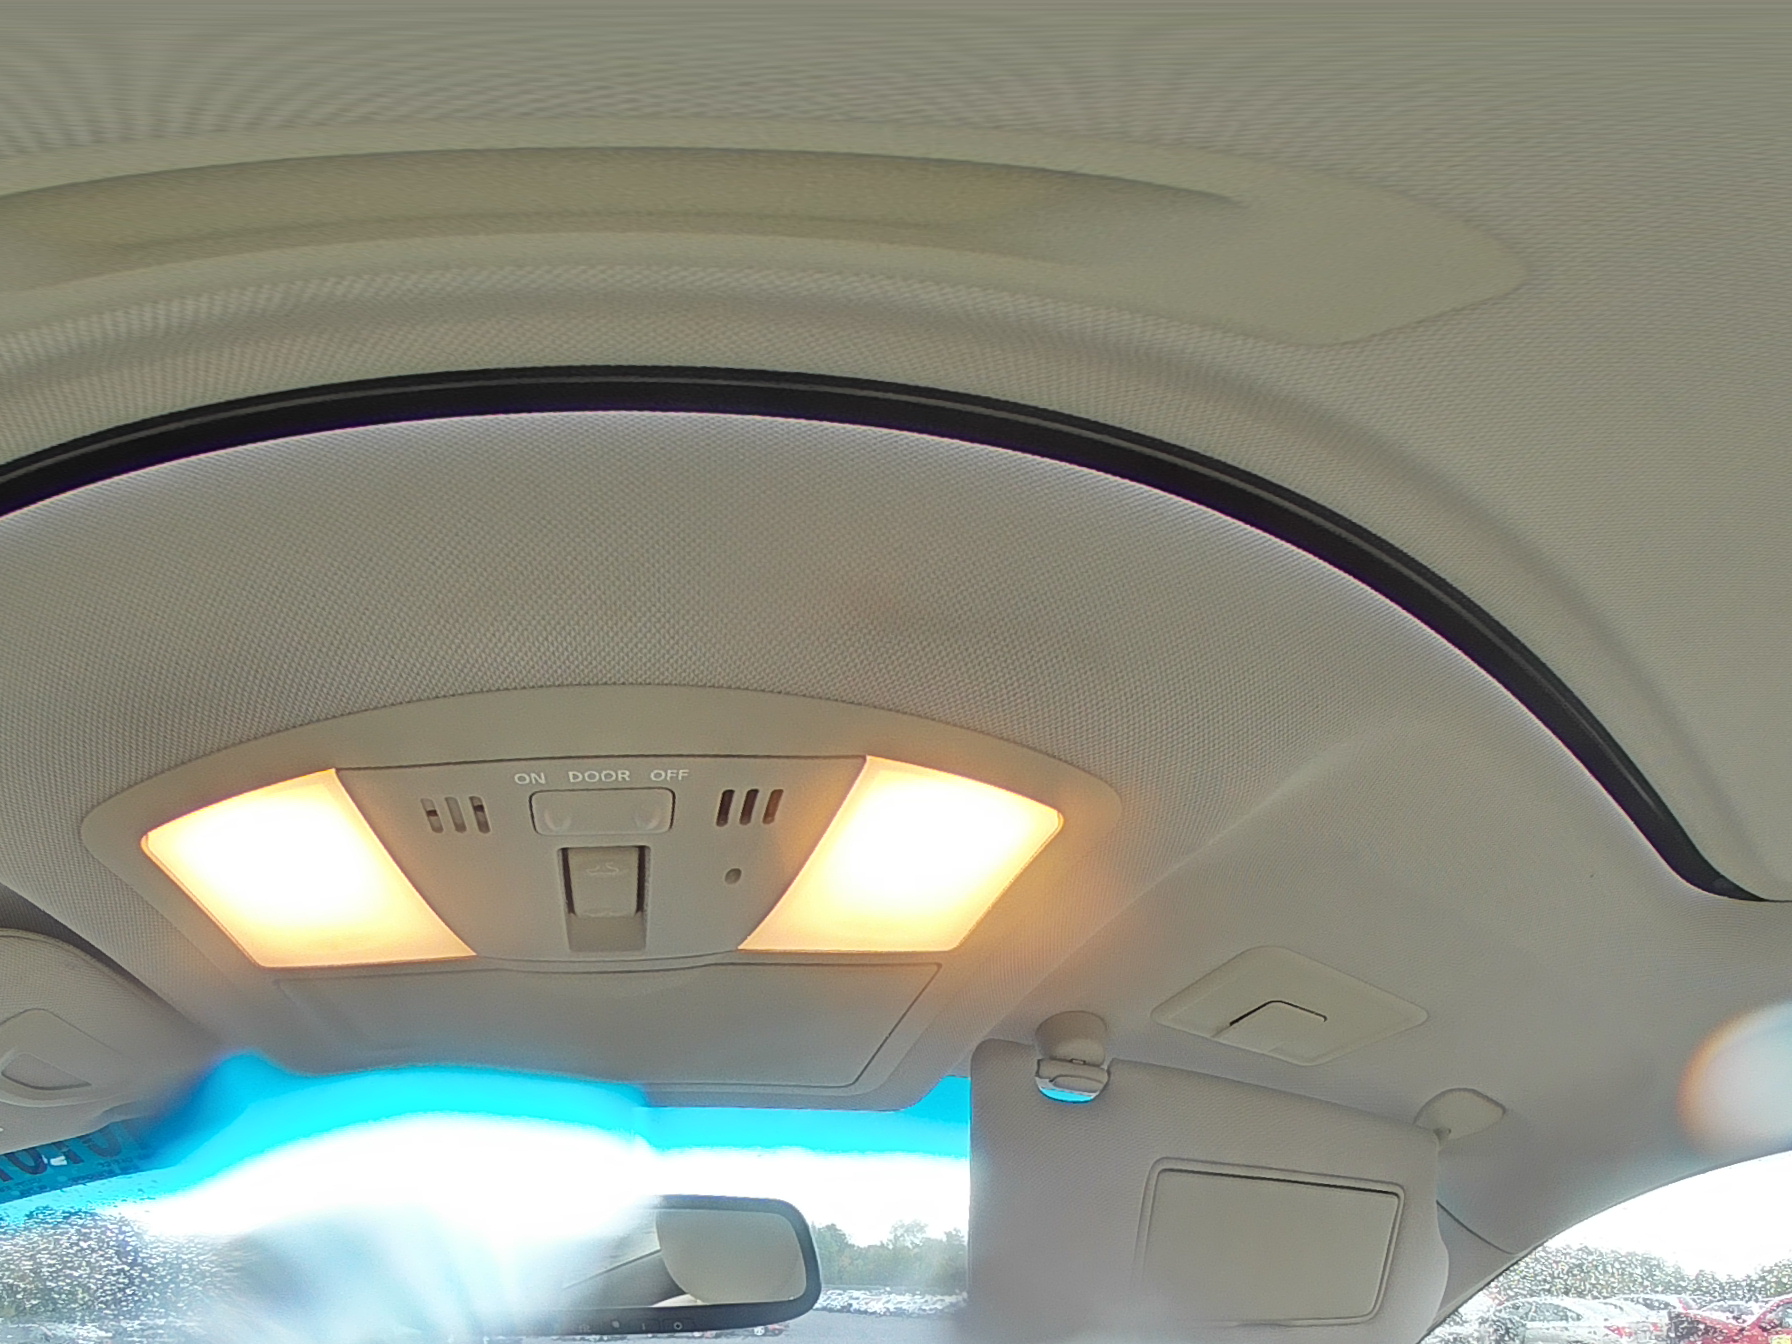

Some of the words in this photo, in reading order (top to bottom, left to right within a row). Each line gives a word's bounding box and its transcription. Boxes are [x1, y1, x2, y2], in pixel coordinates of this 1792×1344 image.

[514, 771, 546, 785] ON
[568, 769, 630, 783] DOOR
[650, 768, 690, 782] OFF
